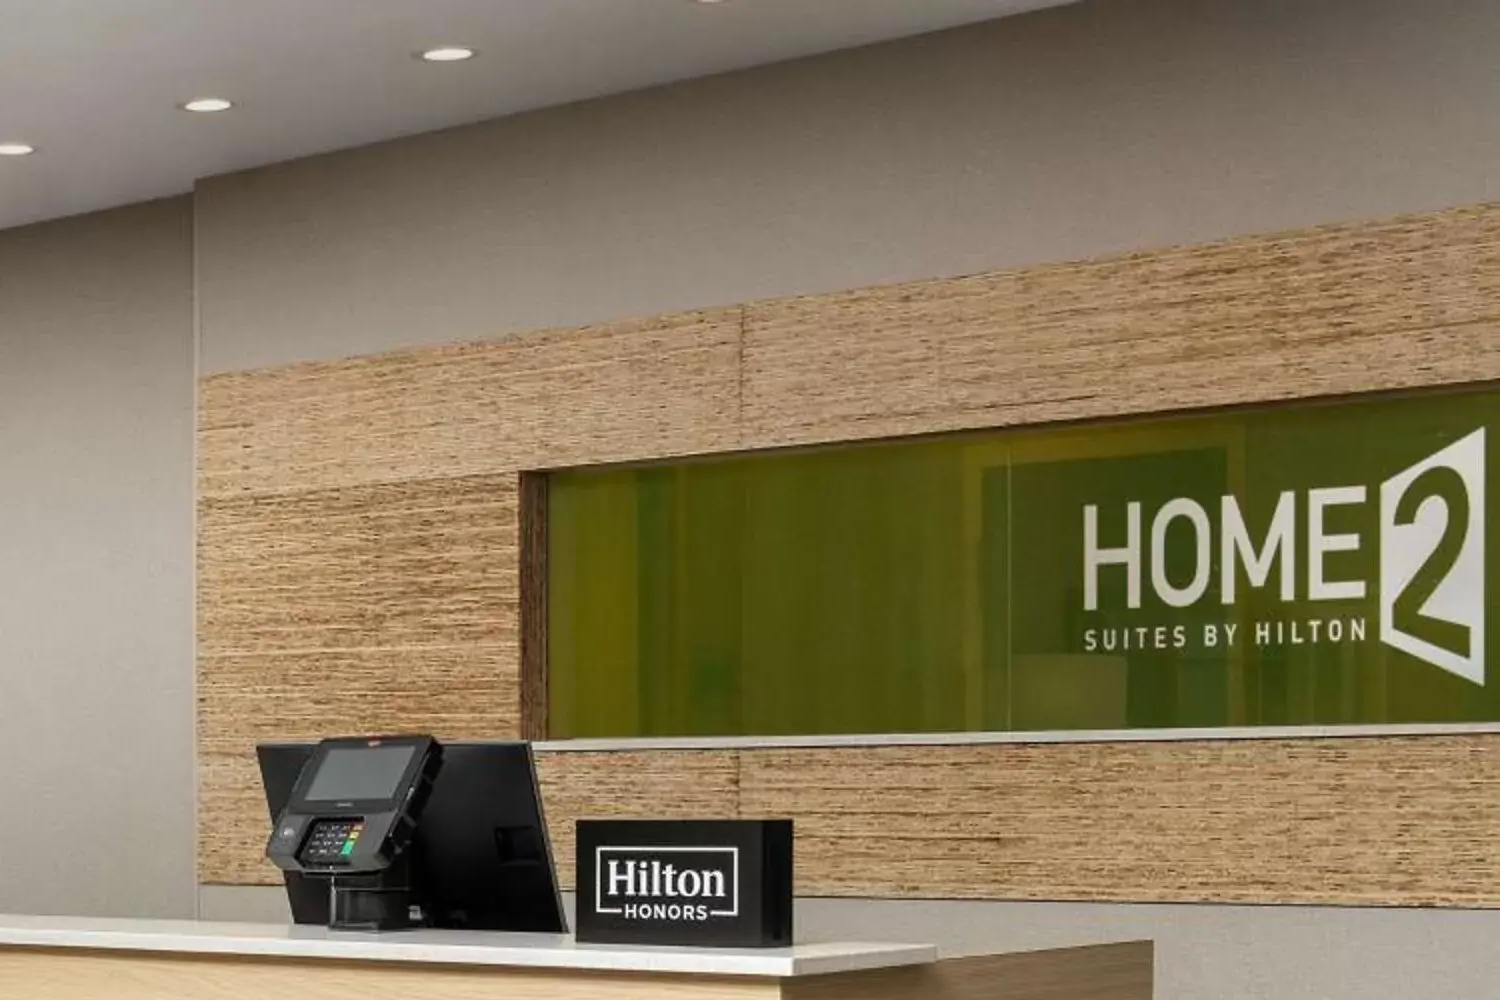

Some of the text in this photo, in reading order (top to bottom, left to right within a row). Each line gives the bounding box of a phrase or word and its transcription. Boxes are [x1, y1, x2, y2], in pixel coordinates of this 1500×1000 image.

[1084, 618, 1366, 650] SUITES BY HILTON
[607, 859, 726, 897] Hilton
[624, 903, 708, 920] HONORS
